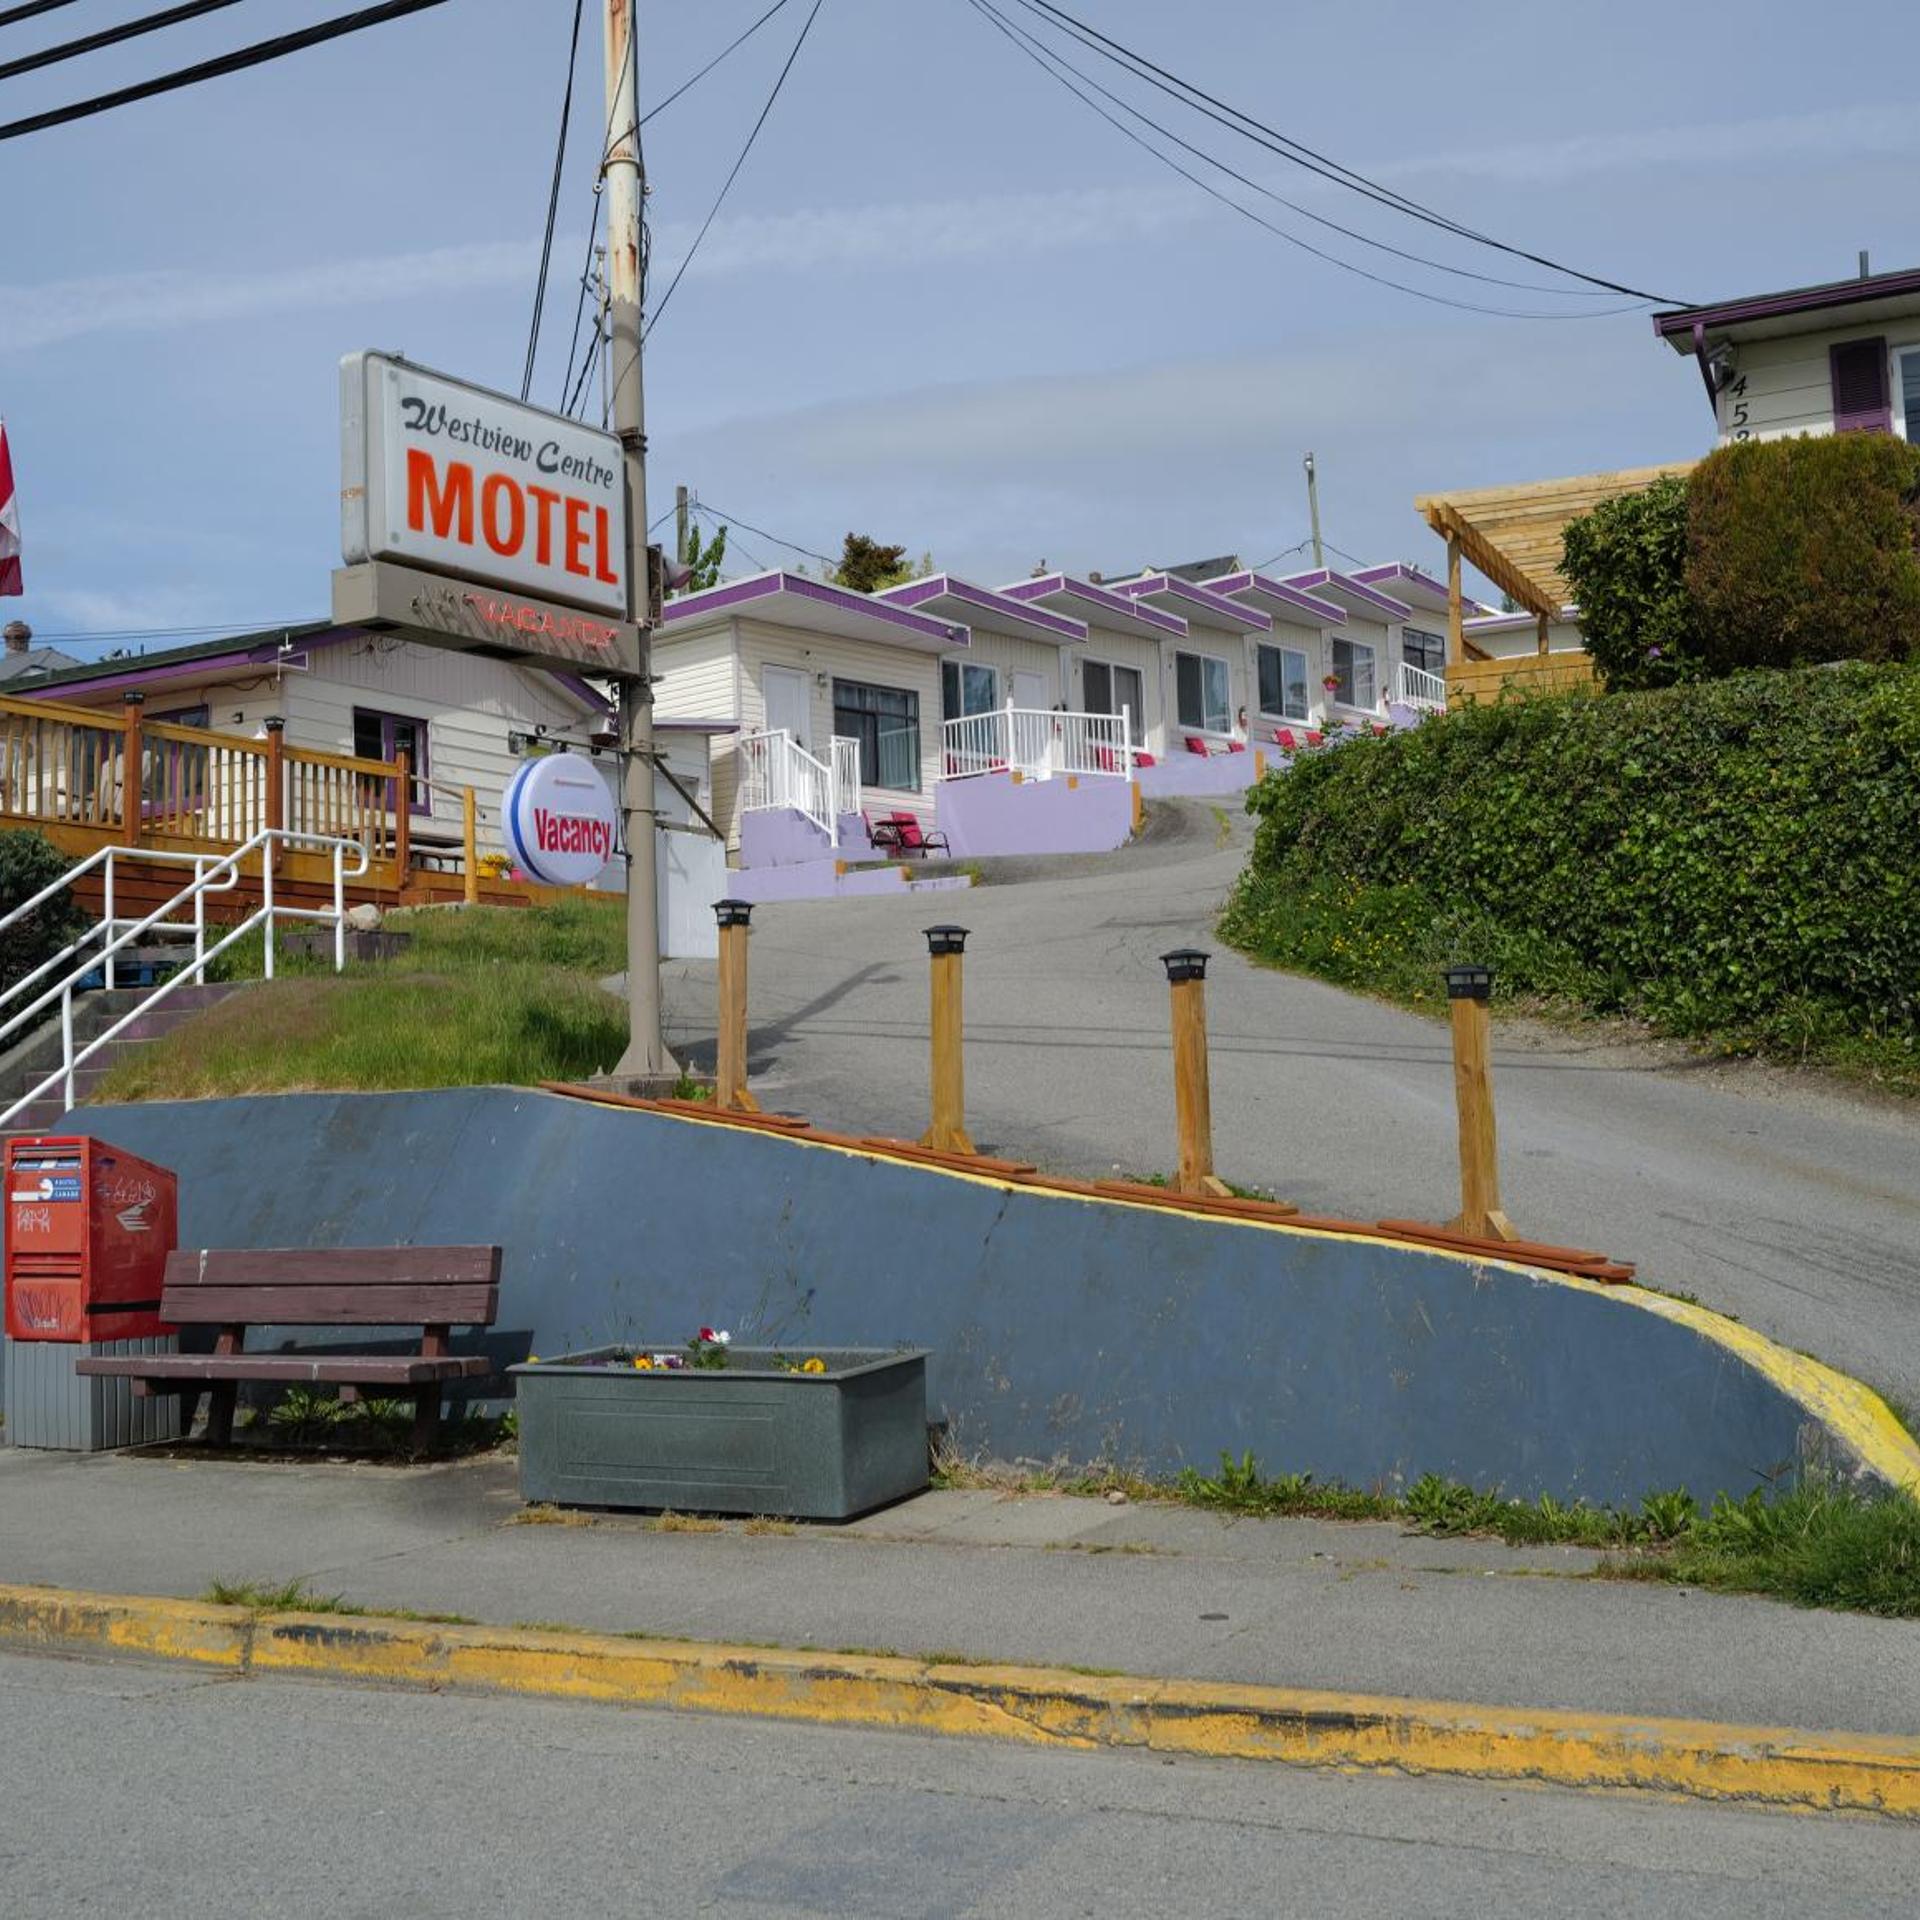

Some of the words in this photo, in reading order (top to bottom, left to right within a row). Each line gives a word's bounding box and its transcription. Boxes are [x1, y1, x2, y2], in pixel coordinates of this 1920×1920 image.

[401, 396, 533, 462] Westview
[535, 441, 615, 490] Centre
[406, 447, 619, 585] MOTEL
[534, 807, 612, 864] Vacancy
